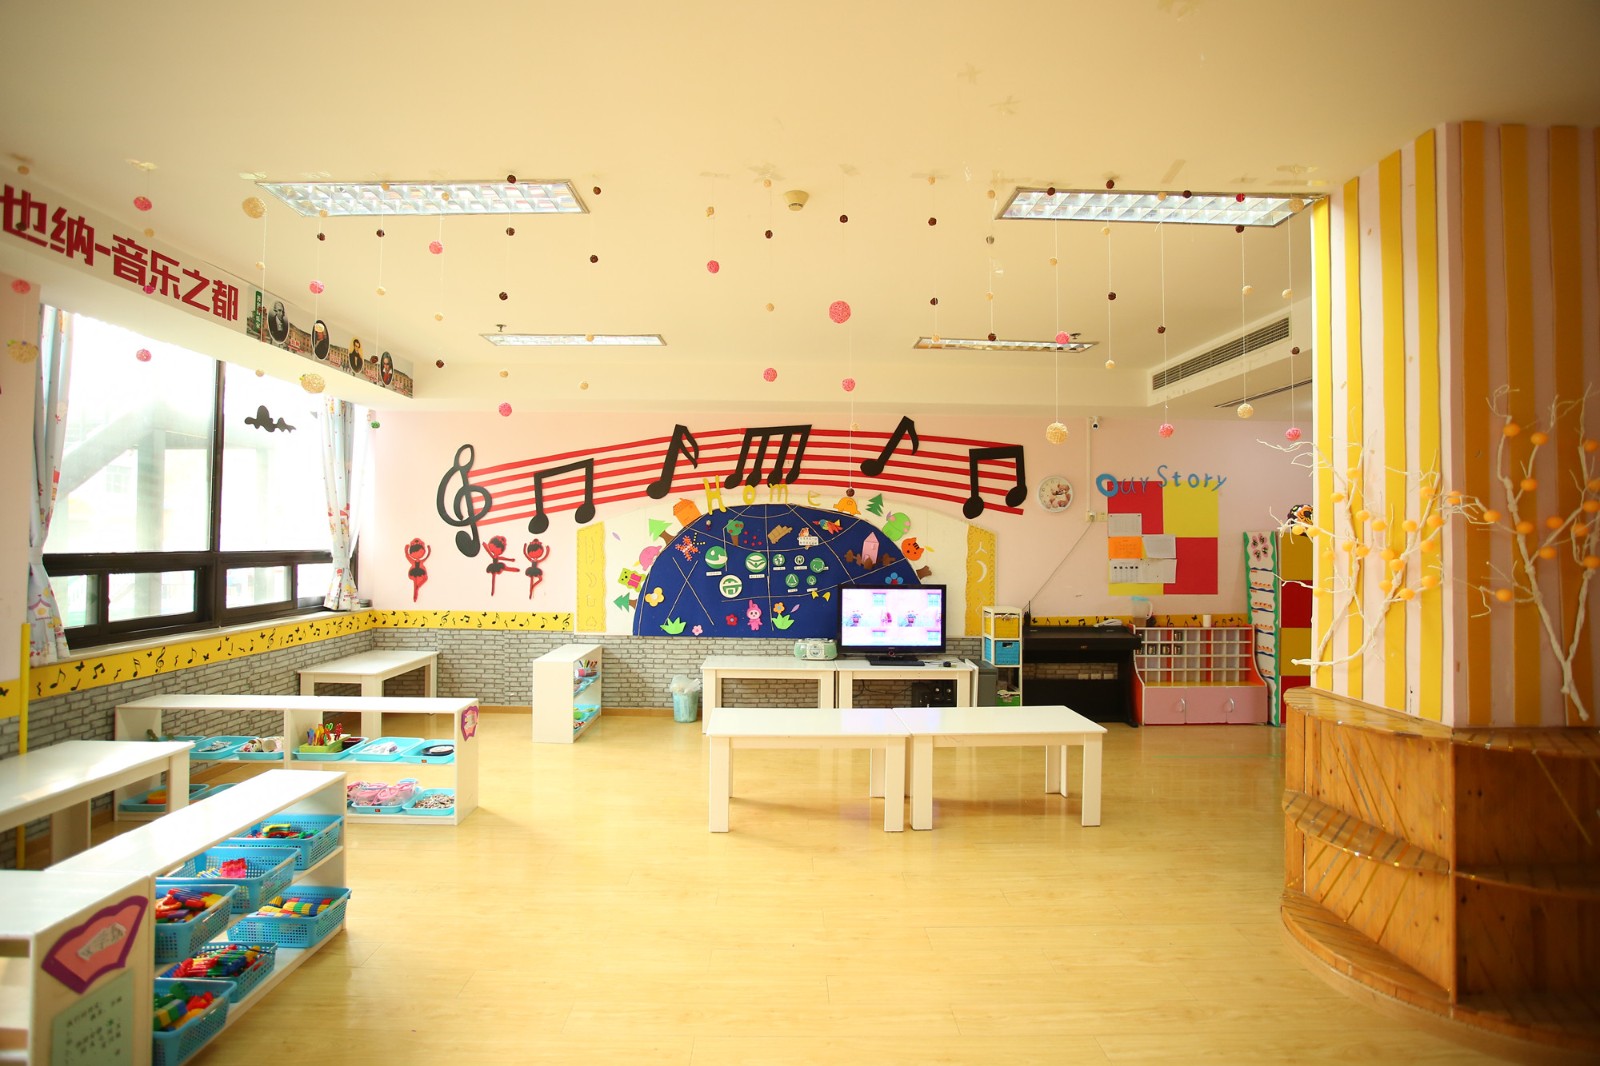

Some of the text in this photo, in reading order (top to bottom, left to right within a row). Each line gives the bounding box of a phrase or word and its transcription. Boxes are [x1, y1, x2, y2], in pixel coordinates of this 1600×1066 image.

[703, 475, 821, 515] Home
[1096, 464, 1227, 497] Our Story
